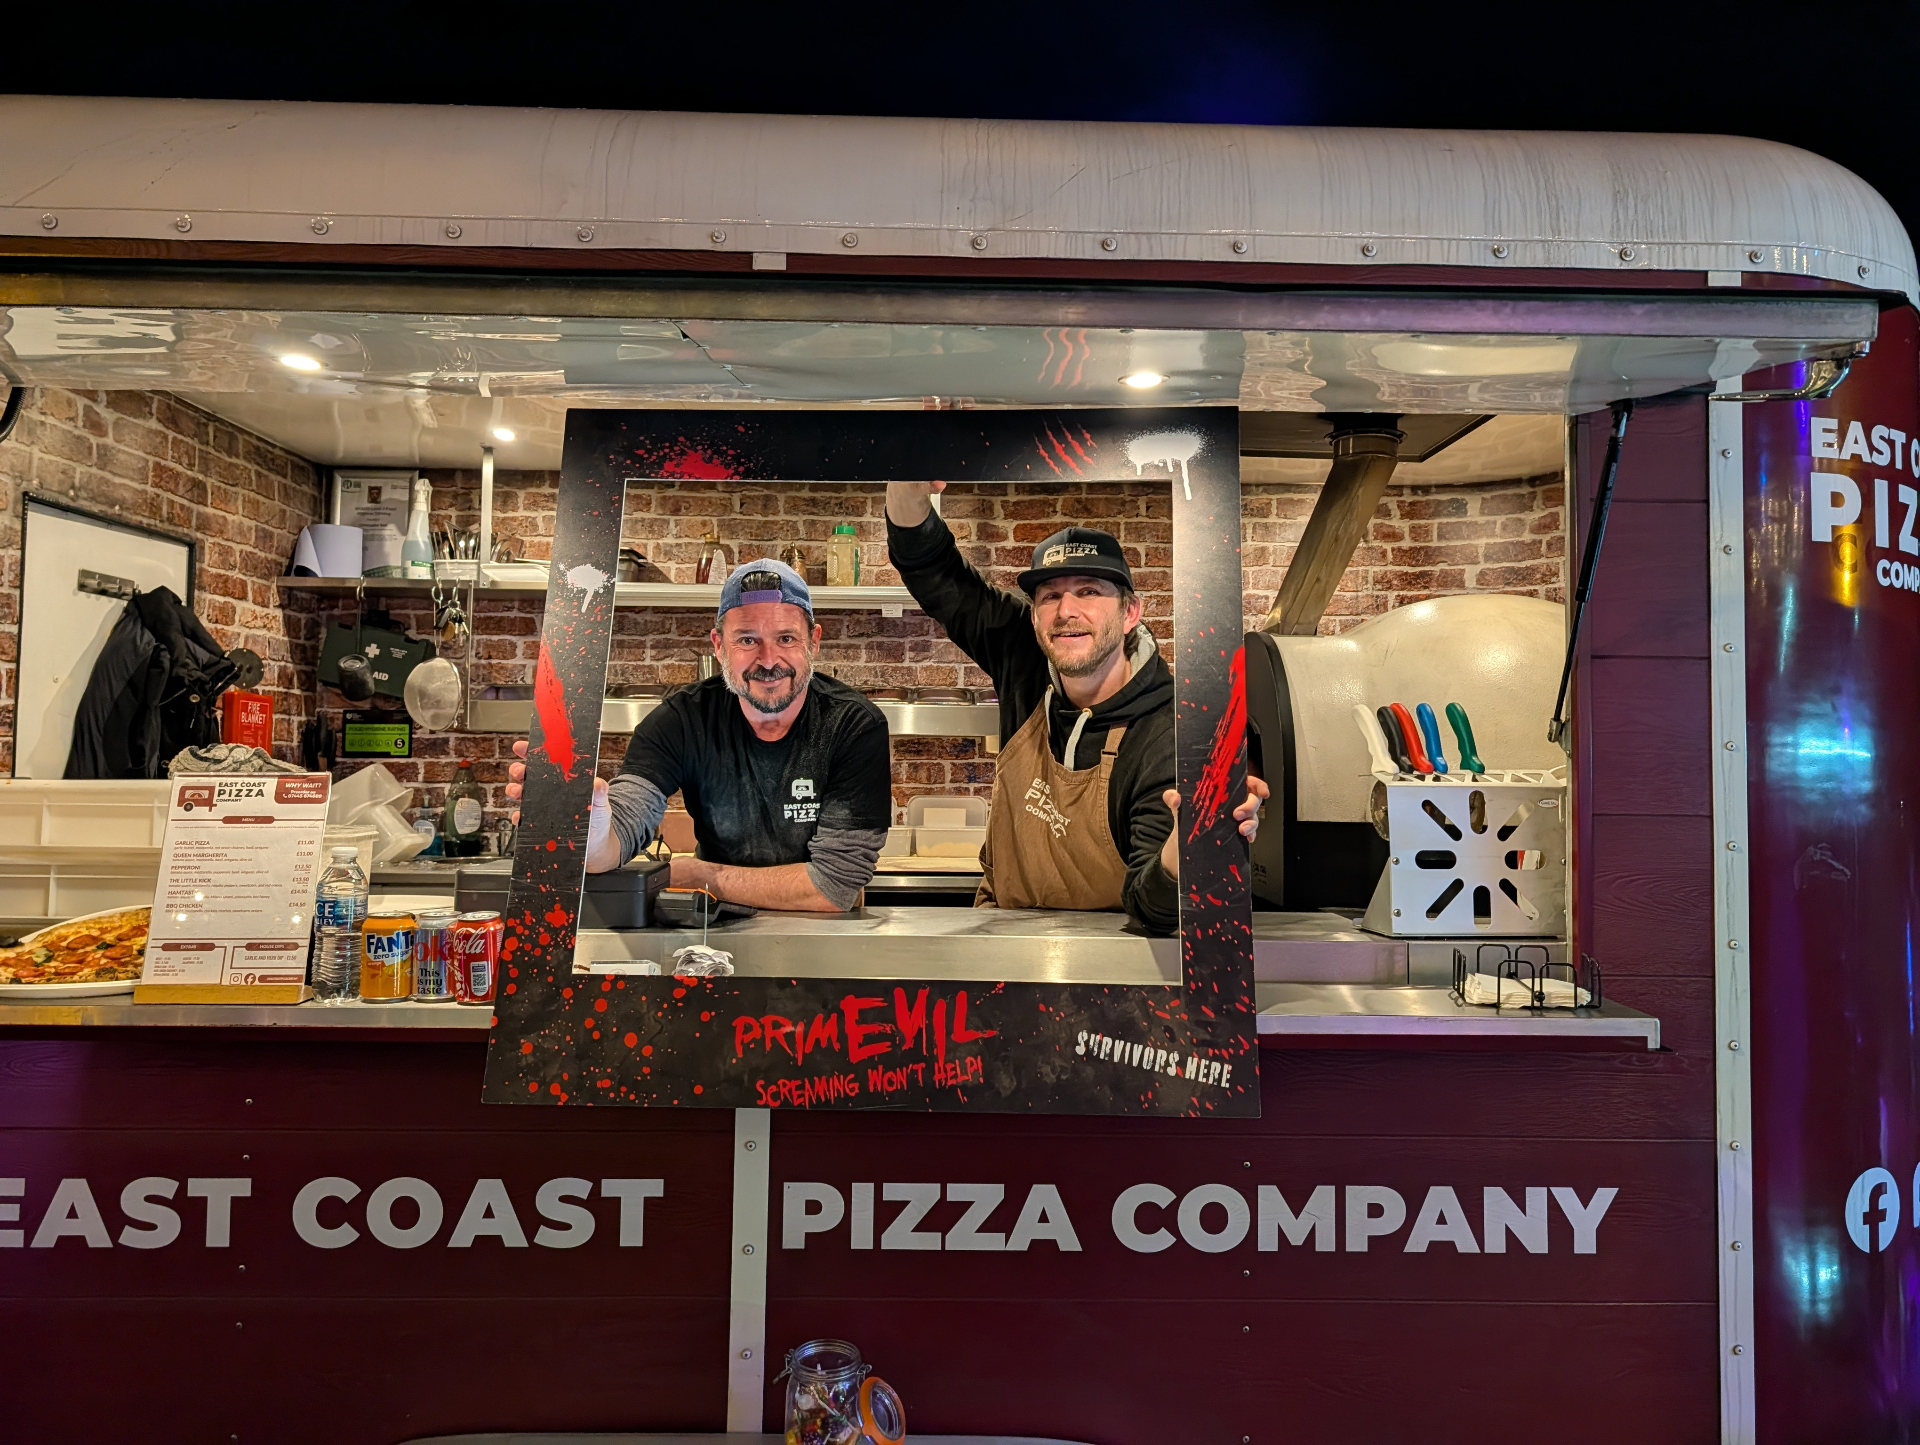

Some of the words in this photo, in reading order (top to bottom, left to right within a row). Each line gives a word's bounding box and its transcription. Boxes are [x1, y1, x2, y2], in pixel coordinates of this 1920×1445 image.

[1810, 416, 1907, 470] EAST
[1066, 548, 1098, 556] PIZZA
[372, 671, 389, 681] AID
[248, 702, 260, 714] FIRE
[241, 712, 266, 724] BLANKET
[396, 738, 403, 748] 5
[217, 788, 265, 798] PIZZA
[1032, 778, 1051, 796] EAS
[419, 968, 440, 977] This
[418, 977, 424, 986] is
[425, 978, 442, 986] my
[418, 986, 442, 994] taste
[732, 987, 998, 1066] PRIMEVIL
[1075, 1030, 1180, 1077] SURVIVORS
[1185, 1056, 1233, 1088] HERE
[868, 1063, 926, 1096] WON'T
[934, 1055, 984, 1089] HELP!
[292, 1177, 664, 1249] COAST
[782, 1181, 1083, 1252] PIZZA
[1111, 1183, 1620, 1255] COMPANY
